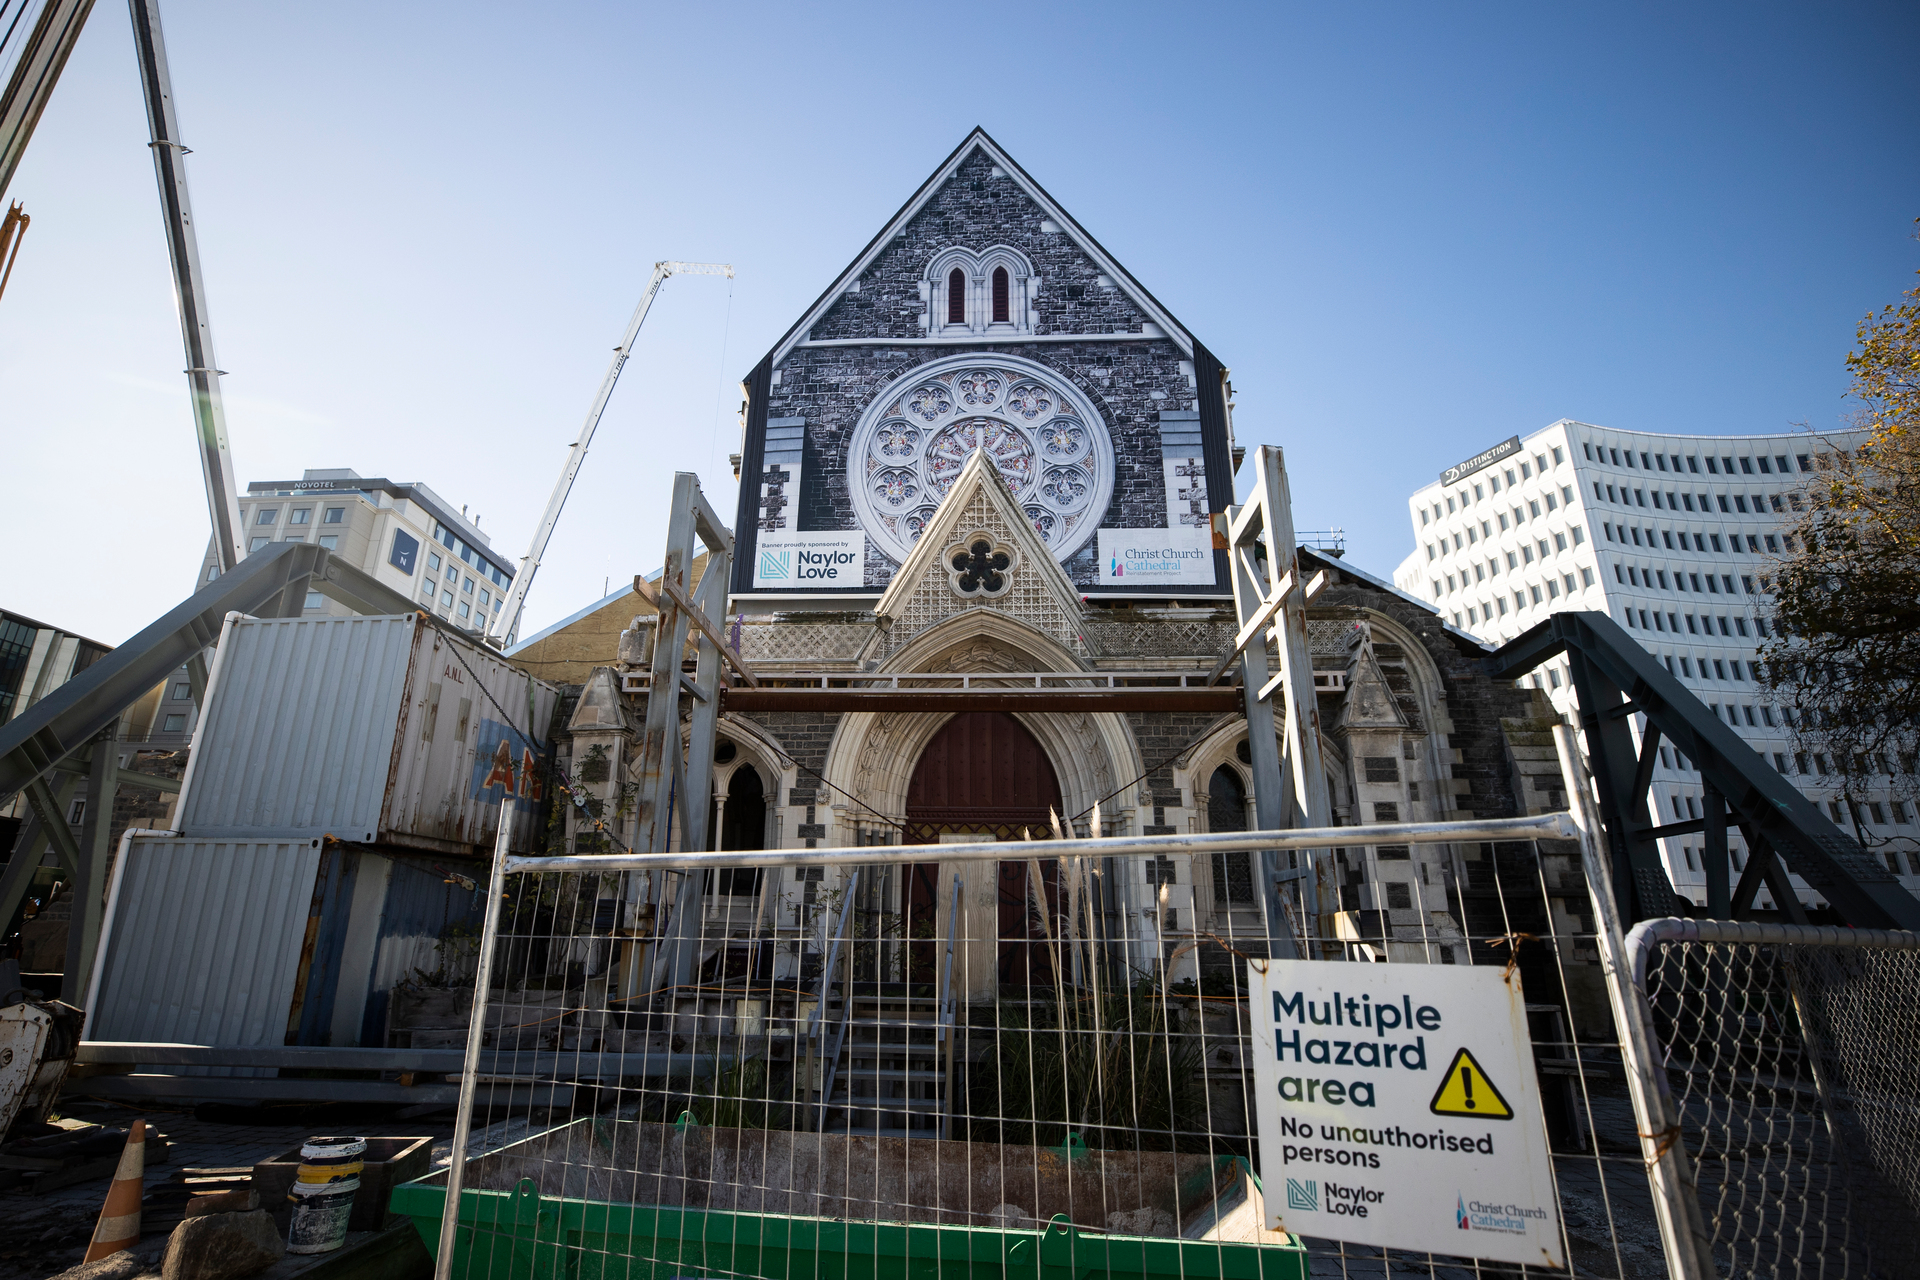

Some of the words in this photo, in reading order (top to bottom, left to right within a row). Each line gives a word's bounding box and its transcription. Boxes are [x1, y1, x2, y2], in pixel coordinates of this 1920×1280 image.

[1460, 441, 1511, 473] DISTINCTION
[294, 481, 335, 489] NOVOTEL
[798, 550, 856, 567] Naylor
[1125, 548, 1160, 559] Christ
[1161, 547, 1204, 559] Church
[797, 564, 838, 579] Love
[1125, 559, 1181, 571] Cathedral
[1272, 990, 1442, 1037] Multiple
[1275, 1028, 1427, 1071] Hazard
[1277, 1076, 1376, 1107] area
[1280, 1116, 1313, 1139] No
[1321, 1124, 1494, 1155] unauthorised
[1282, 1144, 1381, 1169] persons
[1324, 1181, 1384, 1204] Naylor
[1326, 1197, 1368, 1218] Love
[1469, 1201, 1503, 1215] Christ
[1505, 1204, 1547, 1219] Church
[1470, 1213, 1525, 1229] Cathedral
